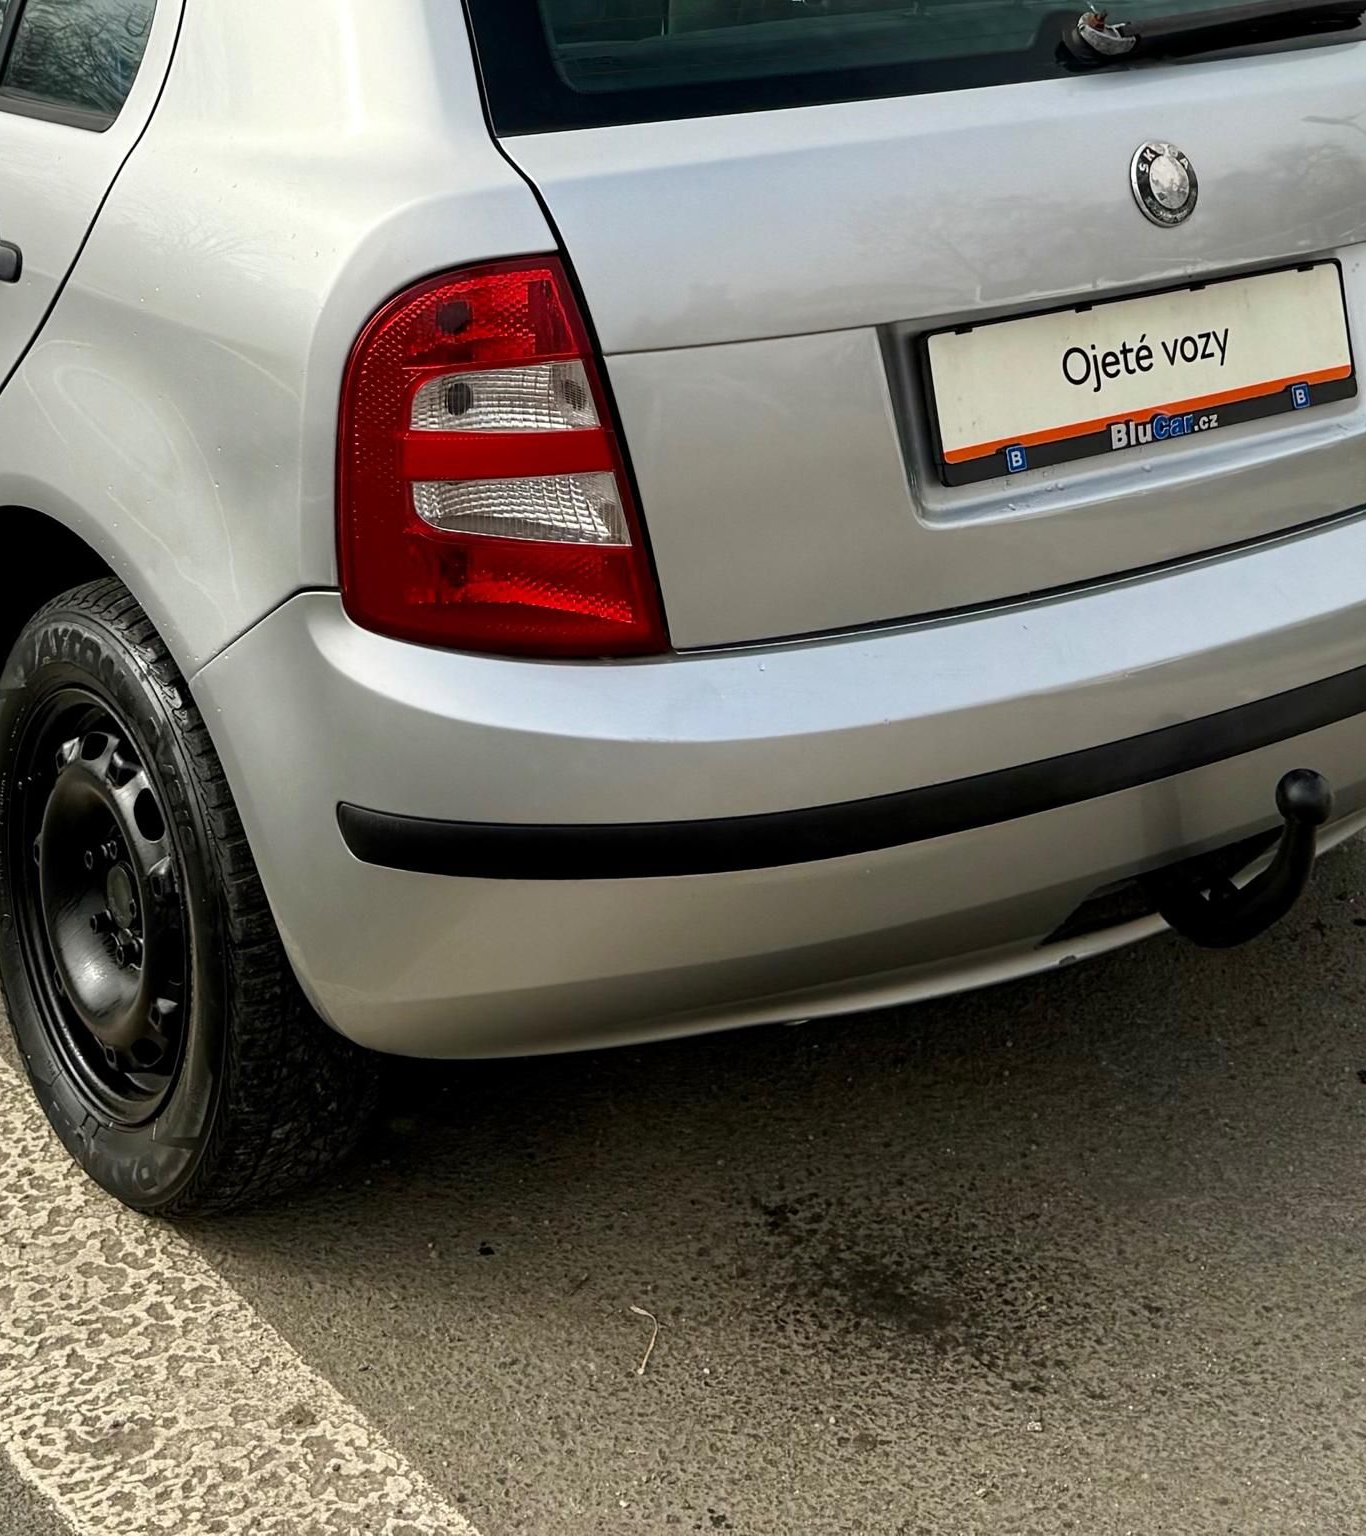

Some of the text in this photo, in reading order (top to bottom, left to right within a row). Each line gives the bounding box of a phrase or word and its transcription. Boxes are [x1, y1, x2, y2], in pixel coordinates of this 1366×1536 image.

[1062, 328, 1229, 393] Ojeté vozy
[1294, 389, 1306, 405] B
[1110, 413, 1219, 450] BluCar.cz
[1011, 450, 1023, 468] B
